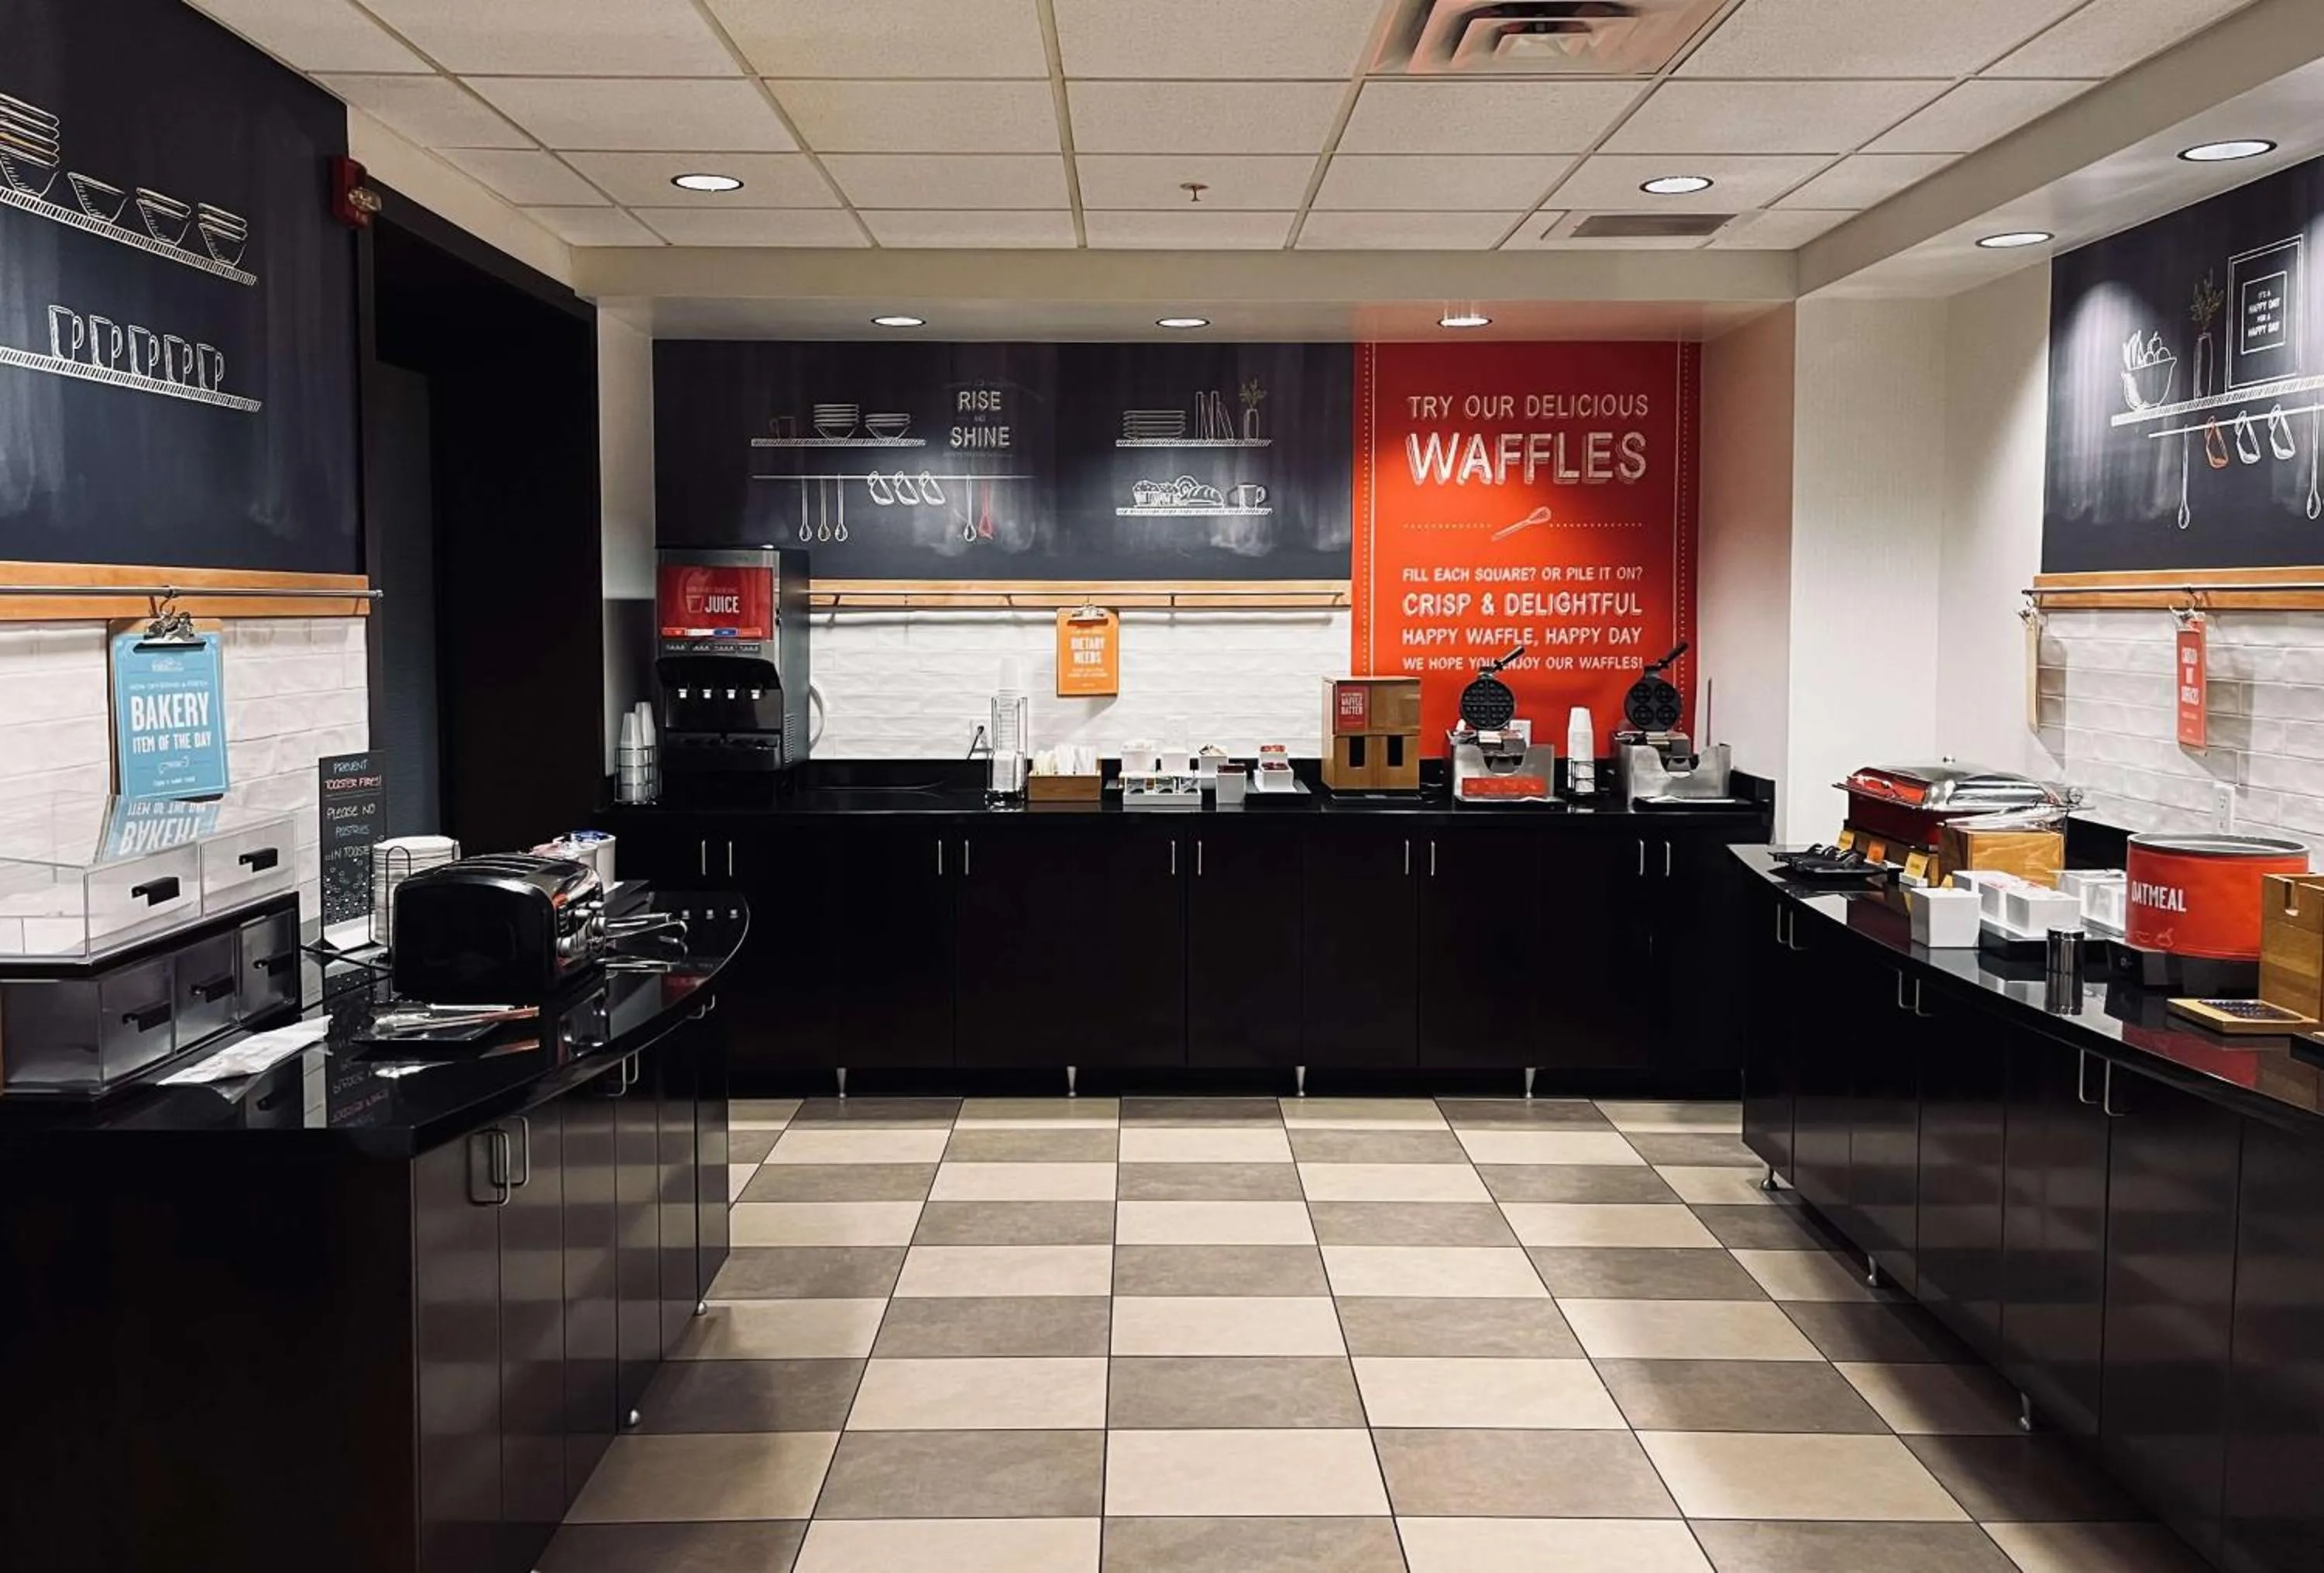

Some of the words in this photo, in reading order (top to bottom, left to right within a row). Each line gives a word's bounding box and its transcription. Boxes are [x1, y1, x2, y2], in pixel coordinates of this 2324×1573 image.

[2248, 324, 2267, 337] HAPPY
[957, 390, 1002, 411] RISE
[1406, 394, 1453, 418] TRY
[1464, 394, 1515, 418] OUR
[1524, 394, 1649, 418] DELICIOUS
[950, 426, 1010, 448] SHINE
[1404, 431, 1648, 486] WAFFLES
[1402, 567, 1429, 582] FILL
[1434, 567, 1470, 582] EACH
[1474, 567, 1538, 582] SQUARE?
[1542, 566, 1562, 581] OR
[1566, 566, 1594, 581] PILE
[1599, 566, 1611, 580] IT
[1617, 566, 1644, 581] ON?
[704, 595, 741, 614] JUICE
[1402, 592, 1472, 618] CRISP
[1480, 592, 1496, 616] &
[1504, 591, 1643, 617] DELIGHTFUL
[1401, 628, 1459, 645] HAPPY
[1466, 627, 1538, 647] WAFFLE,
[1544, 627, 1602, 645] HAPPY
[1608, 626, 1642, 645] DAY
[1403, 657, 1425, 670] WE
[1428, 657, 1464, 670] HOPE
[1501, 657, 1541, 670] NJOY
[1546, 657, 1574, 670] OUR
[1580, 656, 1644, 670] WAFFLES!
[130, 691, 210, 732] BAKERY
[132, 735, 155, 755] ITEM
[158, 734, 170, 752] OF
[173, 731, 192, 751] THE
[194, 731, 212, 749] DAY
[362, 803, 376, 814] NO
[2131, 880, 2187, 912] OATMEAL
